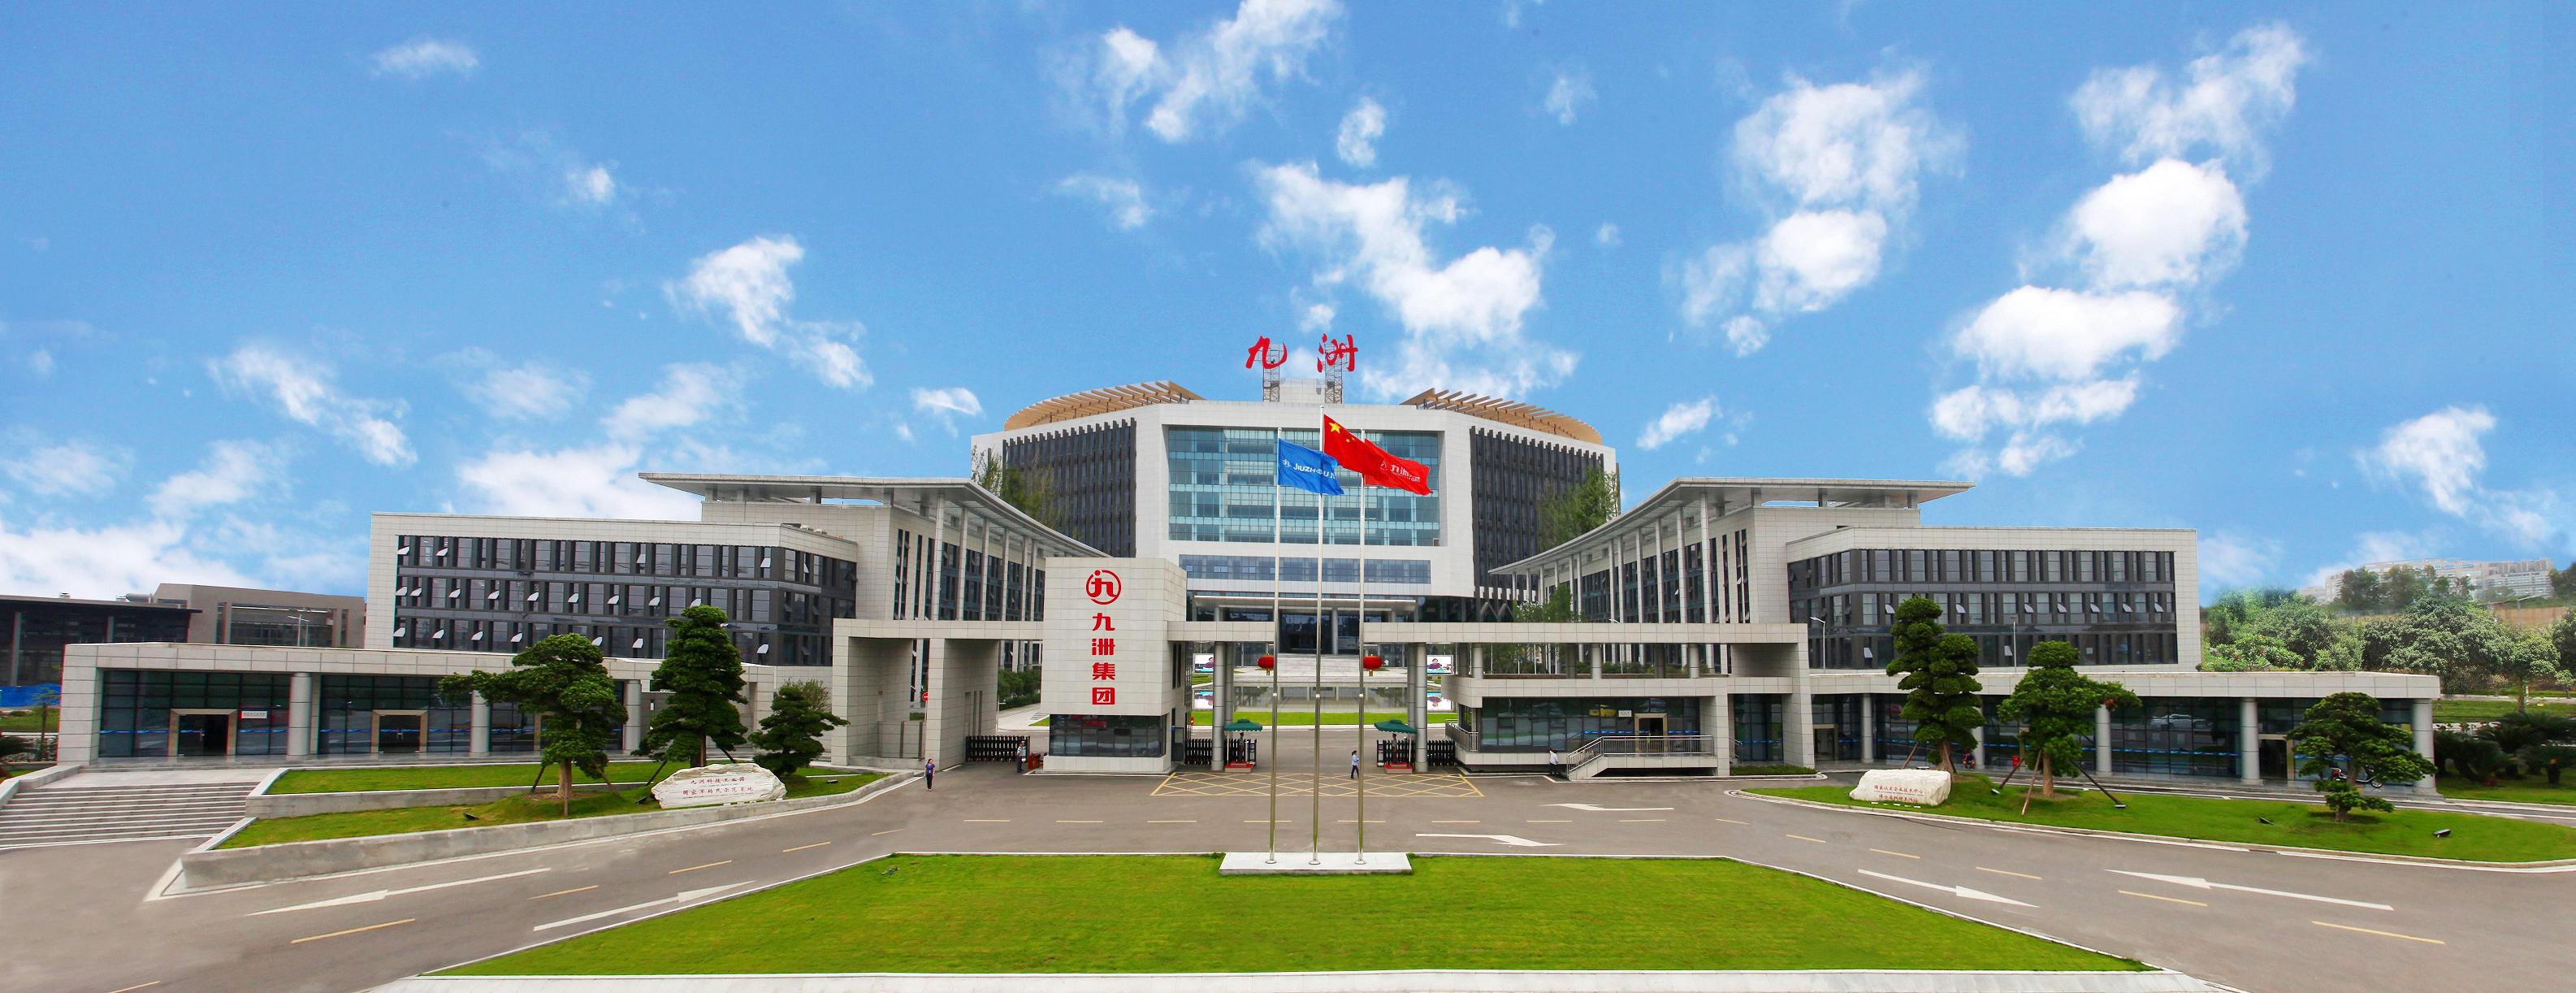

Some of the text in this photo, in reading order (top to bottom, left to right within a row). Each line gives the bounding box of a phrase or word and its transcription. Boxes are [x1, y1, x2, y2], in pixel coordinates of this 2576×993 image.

[1245, 333, 1358, 373] 九洲
[1092, 613, 1115, 705] 九洲集团
